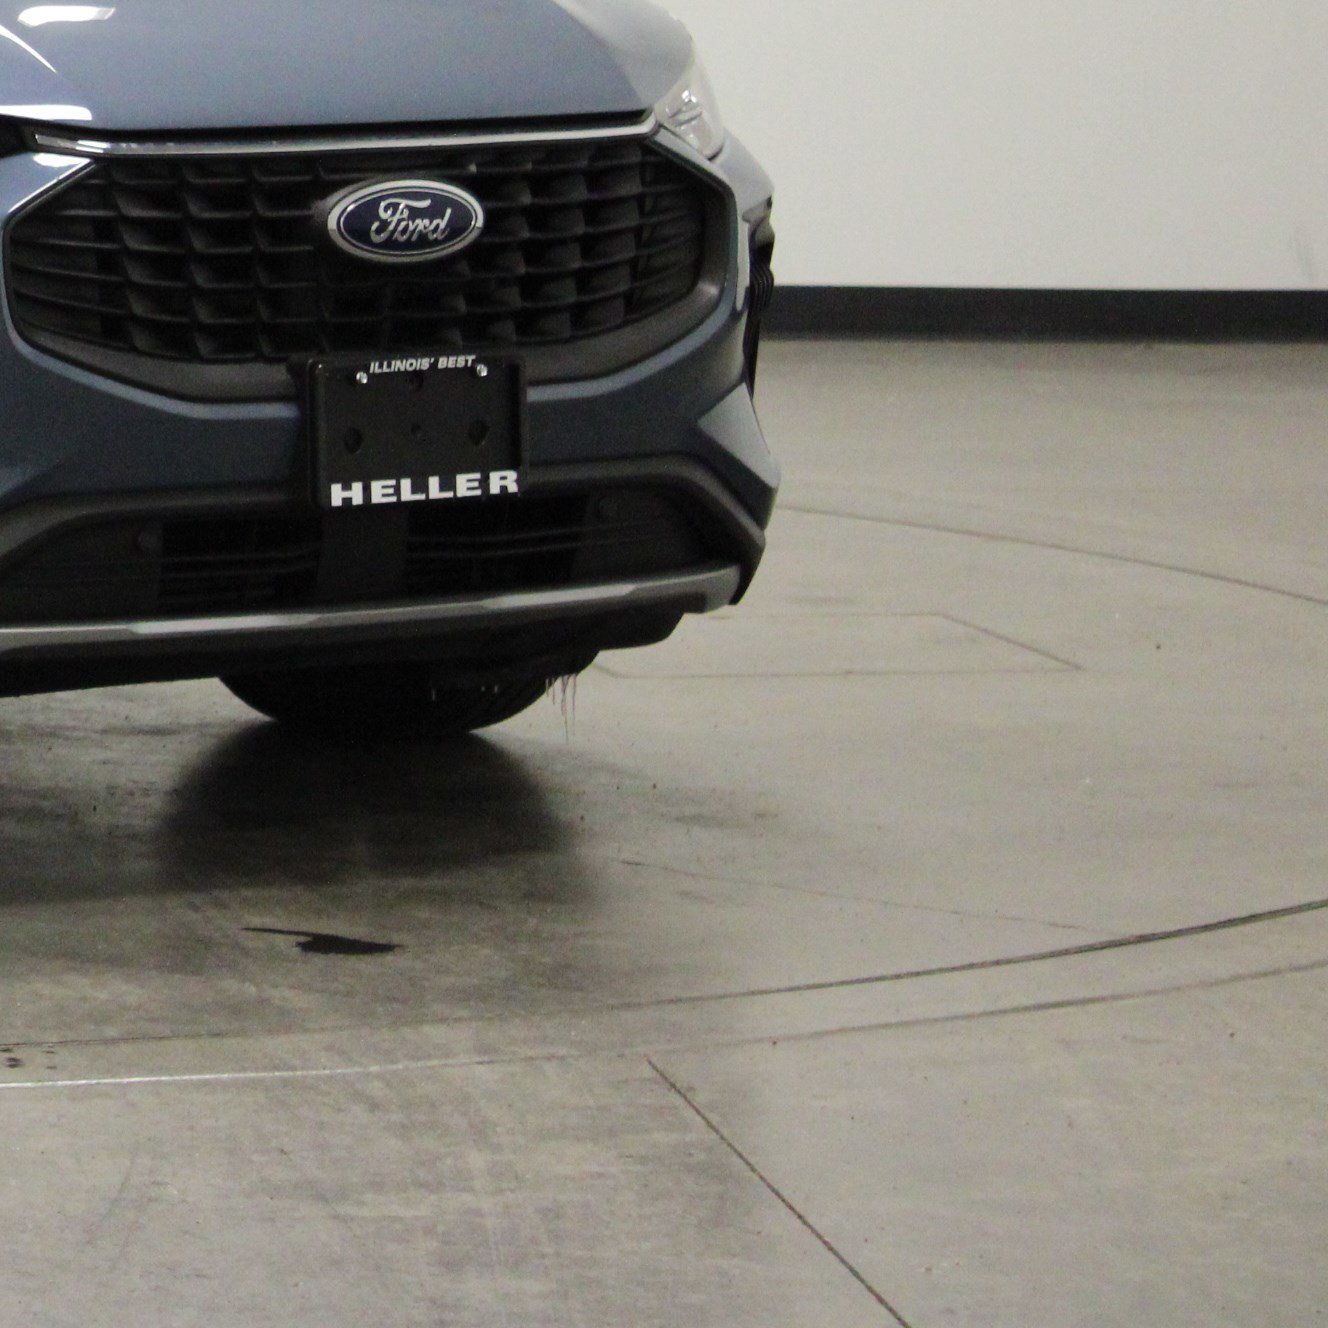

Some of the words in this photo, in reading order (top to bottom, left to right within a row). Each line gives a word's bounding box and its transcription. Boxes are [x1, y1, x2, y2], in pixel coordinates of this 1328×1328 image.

[370, 197, 452, 243] Ford
[438, 355, 476, 369] BEST
[330, 470, 519, 507] HELLER
